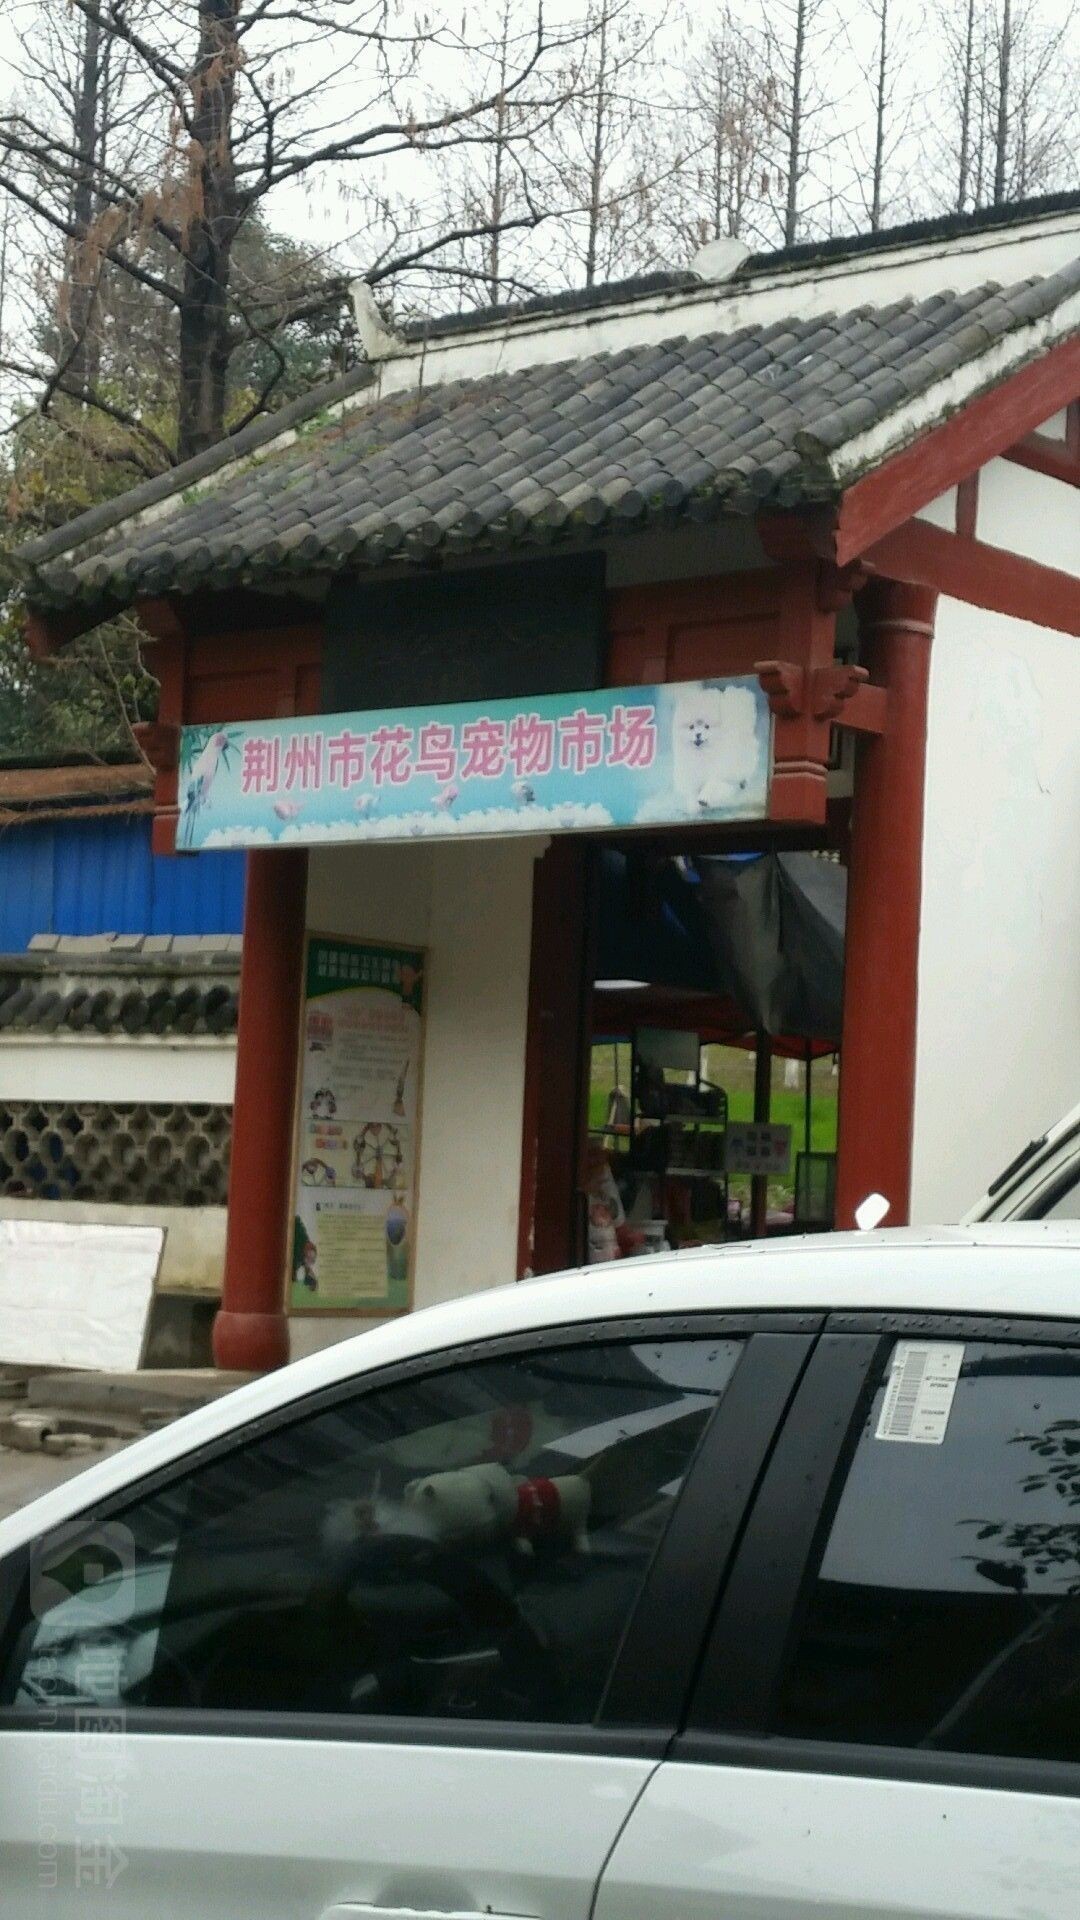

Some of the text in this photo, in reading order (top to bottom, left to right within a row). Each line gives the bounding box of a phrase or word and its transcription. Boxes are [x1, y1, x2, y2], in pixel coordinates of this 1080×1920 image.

[241, 704, 657, 795] 荆州市花鸟宠物市场
